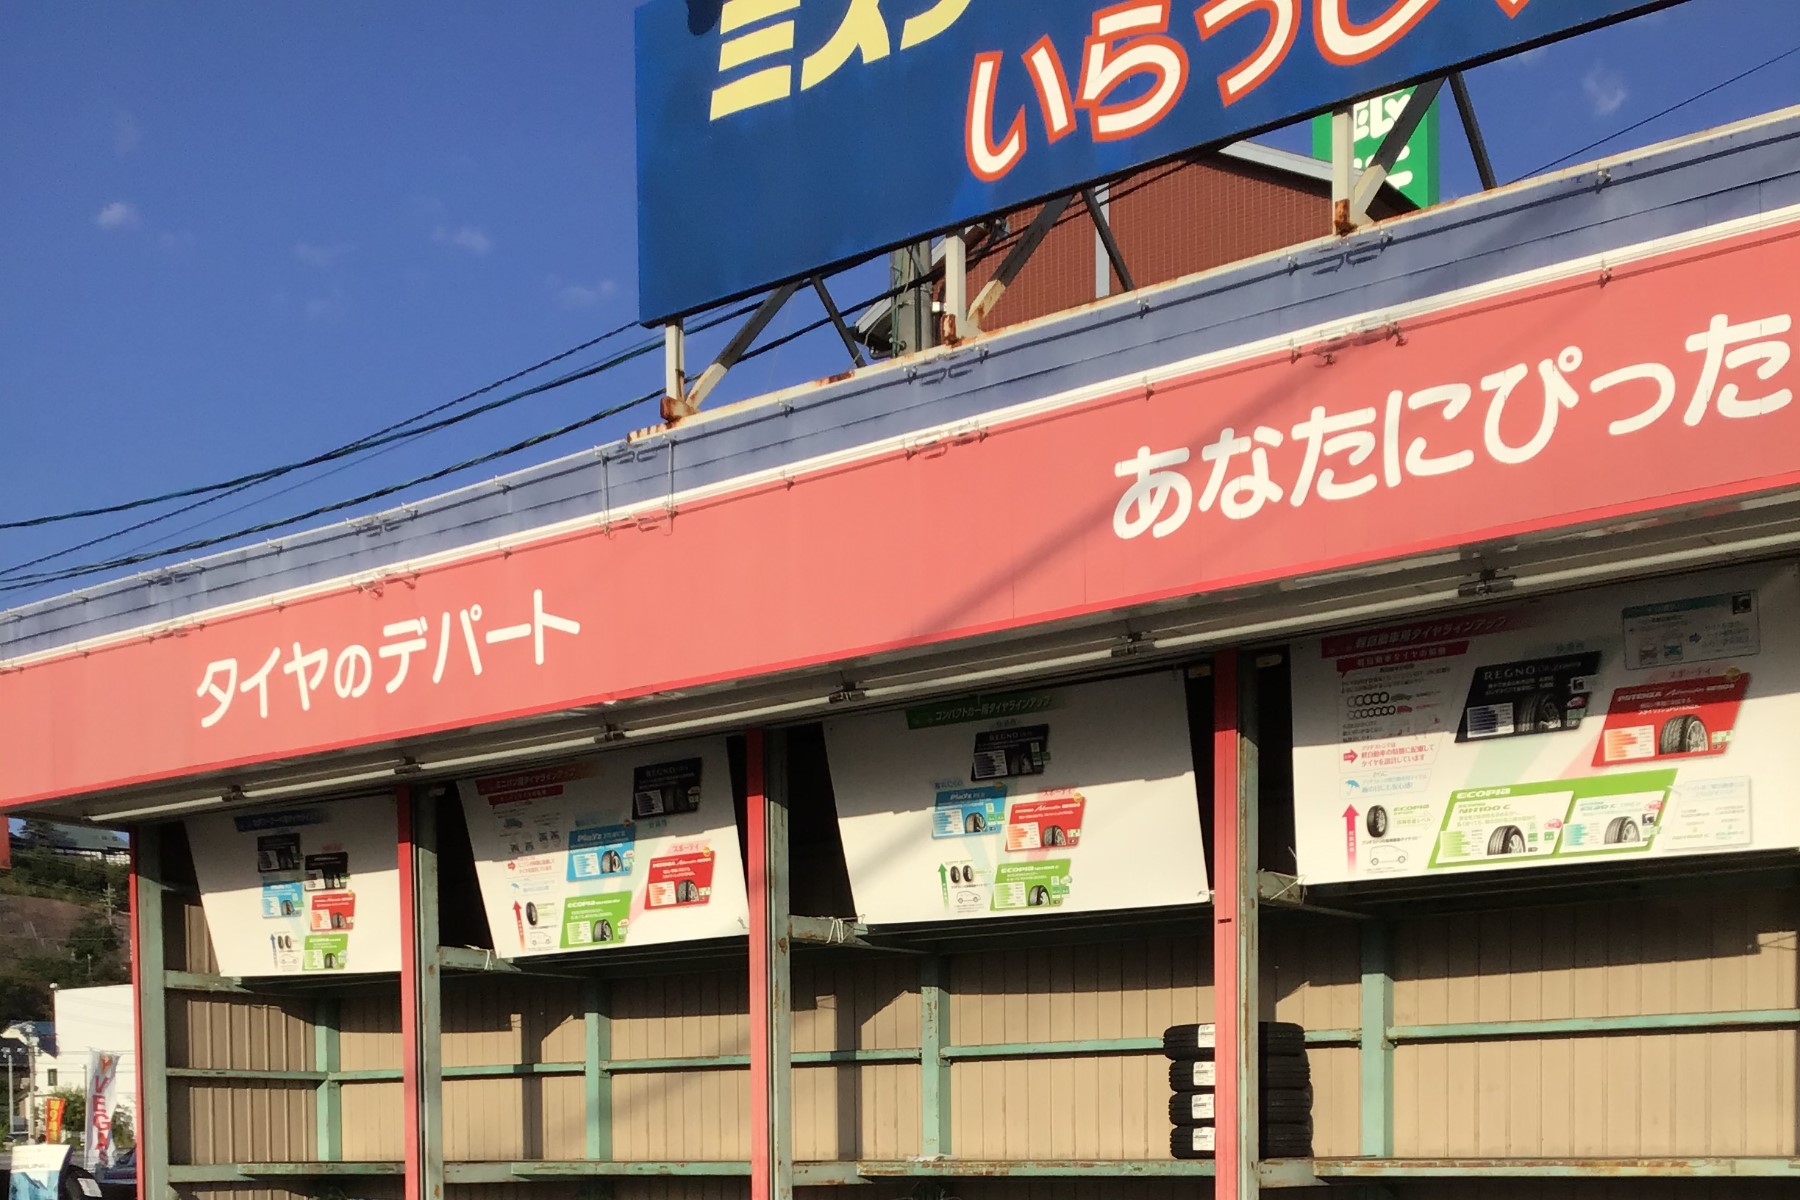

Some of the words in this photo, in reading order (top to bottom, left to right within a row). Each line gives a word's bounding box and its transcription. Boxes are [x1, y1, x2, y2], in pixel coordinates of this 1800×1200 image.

[1113, 314, 1792, 539] あなたにぴった
[197, 589, 580, 728] タイヤのデパート
